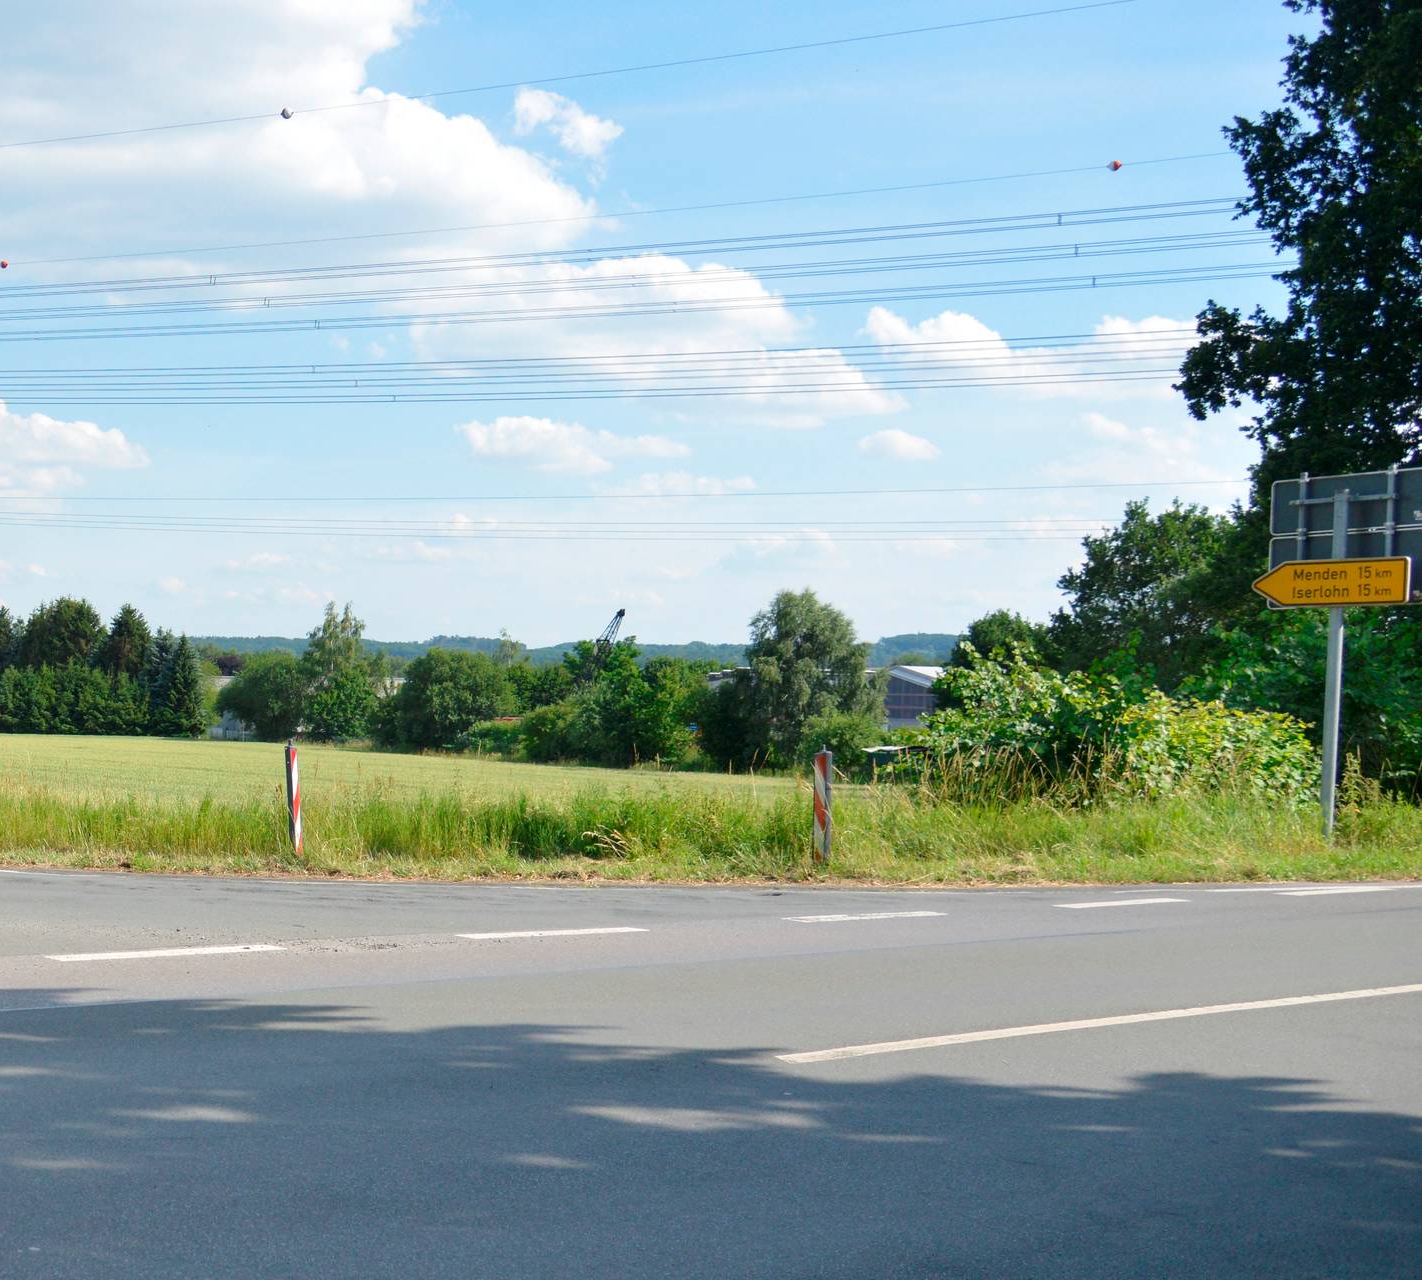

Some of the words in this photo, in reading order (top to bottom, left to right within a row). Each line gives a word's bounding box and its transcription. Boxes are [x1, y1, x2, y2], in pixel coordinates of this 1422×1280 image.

[1293, 569, 1347, 581] Menden
[1358, 566, 1371, 579] 15
[1375, 568, 1392, 578] km
[1292, 585, 1349, 598] Iserlohn
[1357, 584, 1371, 597] 15
[1374, 586, 1392, 596] km
